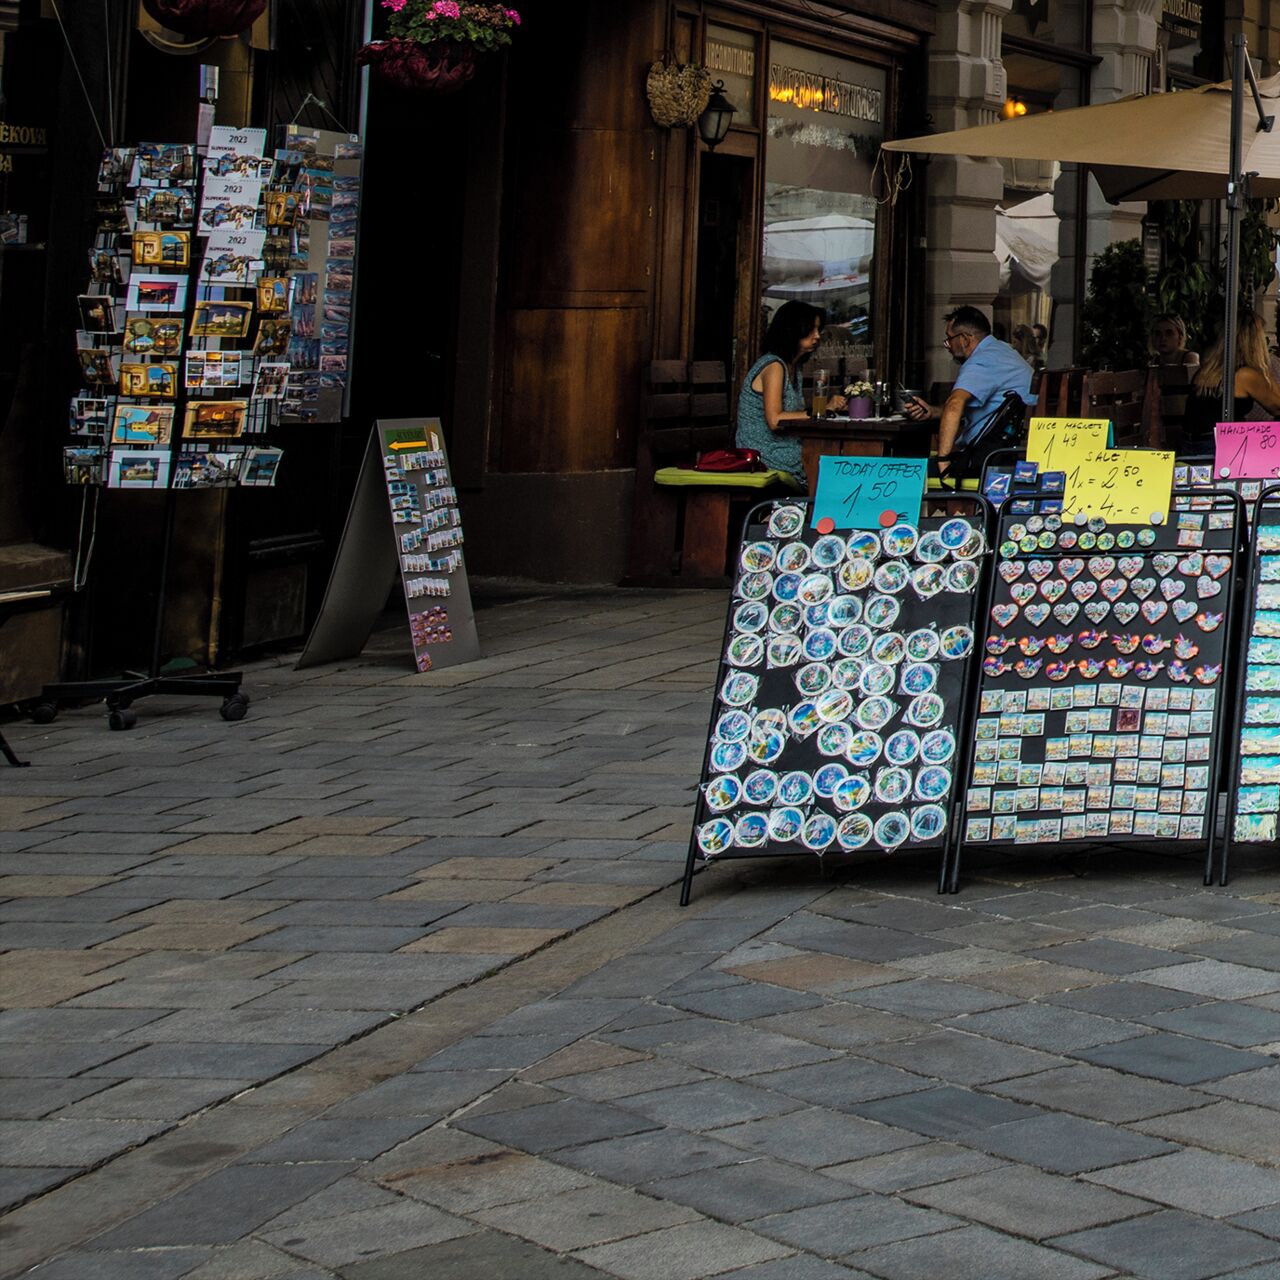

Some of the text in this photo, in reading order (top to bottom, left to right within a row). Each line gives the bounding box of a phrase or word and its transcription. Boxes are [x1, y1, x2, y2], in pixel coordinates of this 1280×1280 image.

[229, 135, 248, 144] 2023
[223, 185, 243, 193] 2023
[228, 236, 247, 244] 2023
[1035, 422, 1057, 430] NICE
[834, 460, 922, 480] TODAY OFFER
